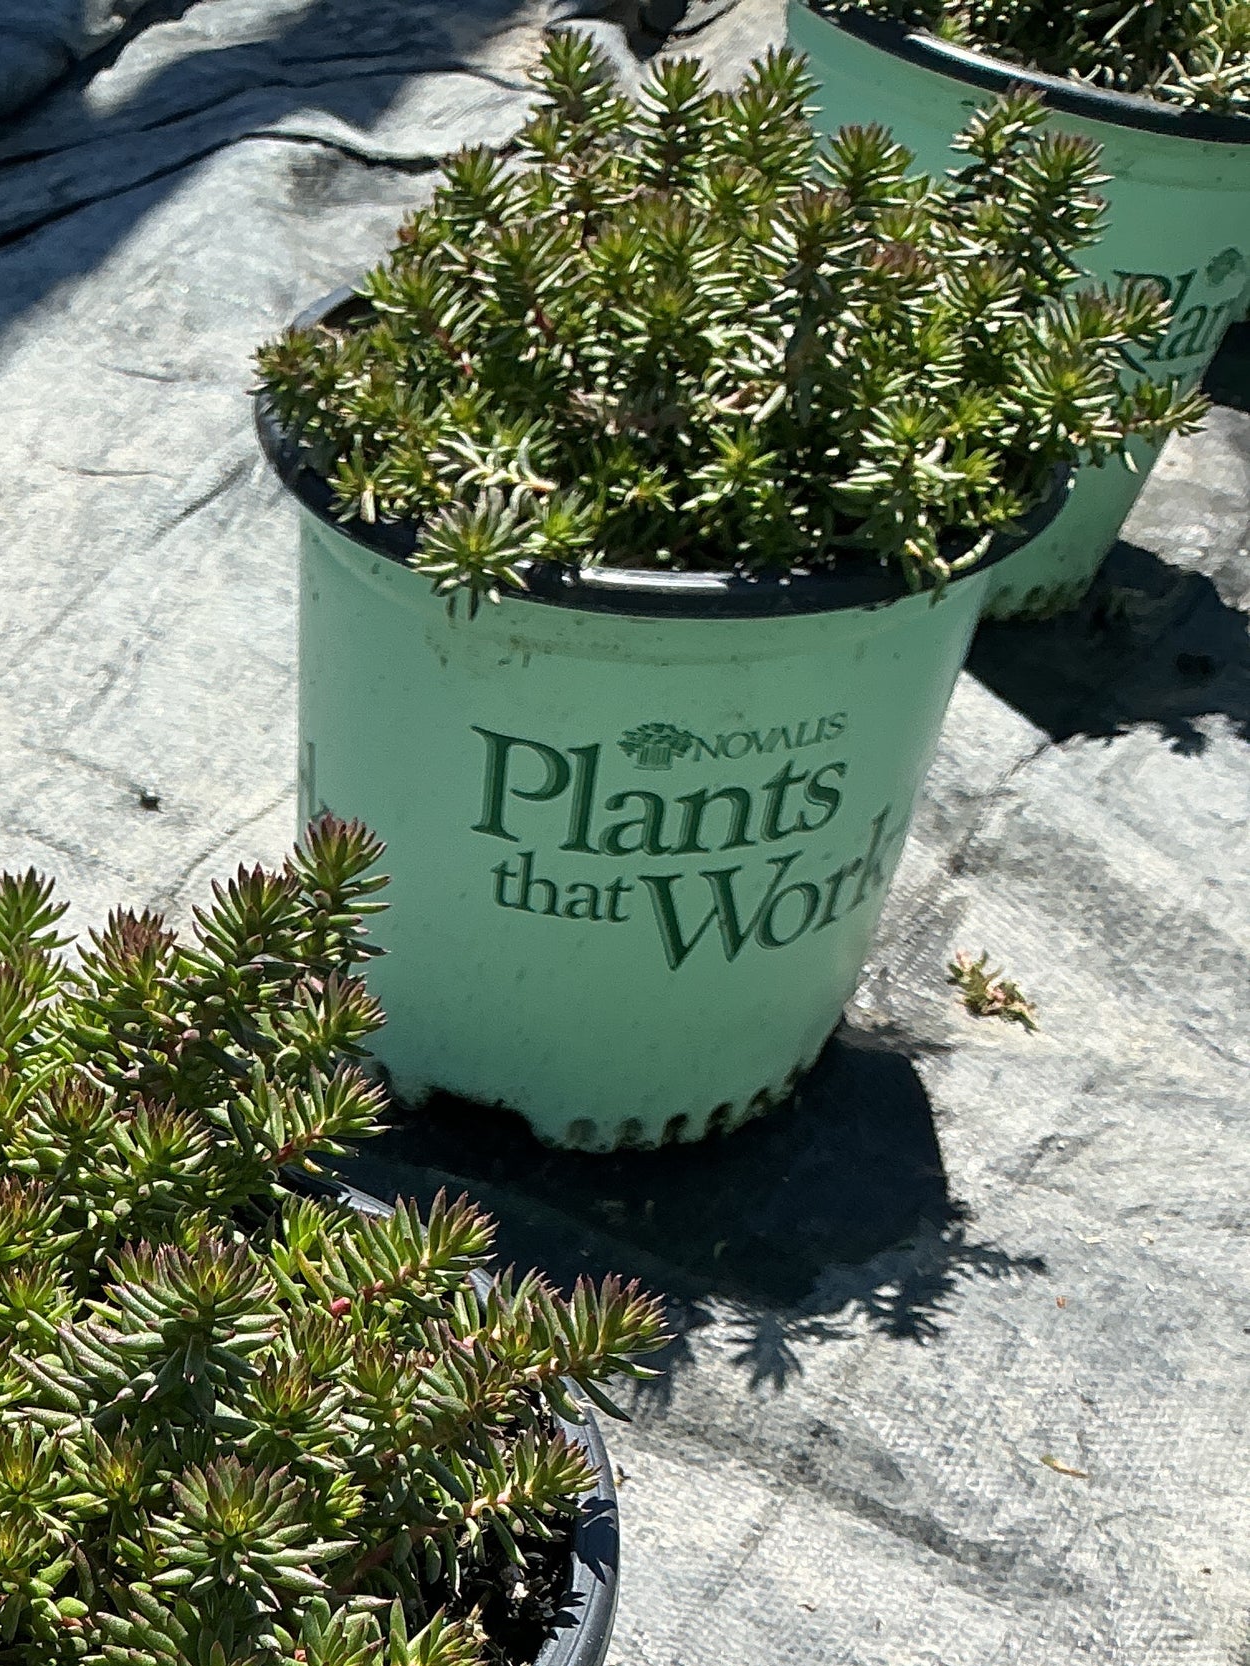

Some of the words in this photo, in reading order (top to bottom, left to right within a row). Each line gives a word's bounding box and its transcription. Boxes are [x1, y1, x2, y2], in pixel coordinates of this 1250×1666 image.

[469, 724, 847, 857] Plants
[692, 711, 847, 763] NOVALIS
[490, 851, 635, 924] that
[637, 802, 906, 972] Work
